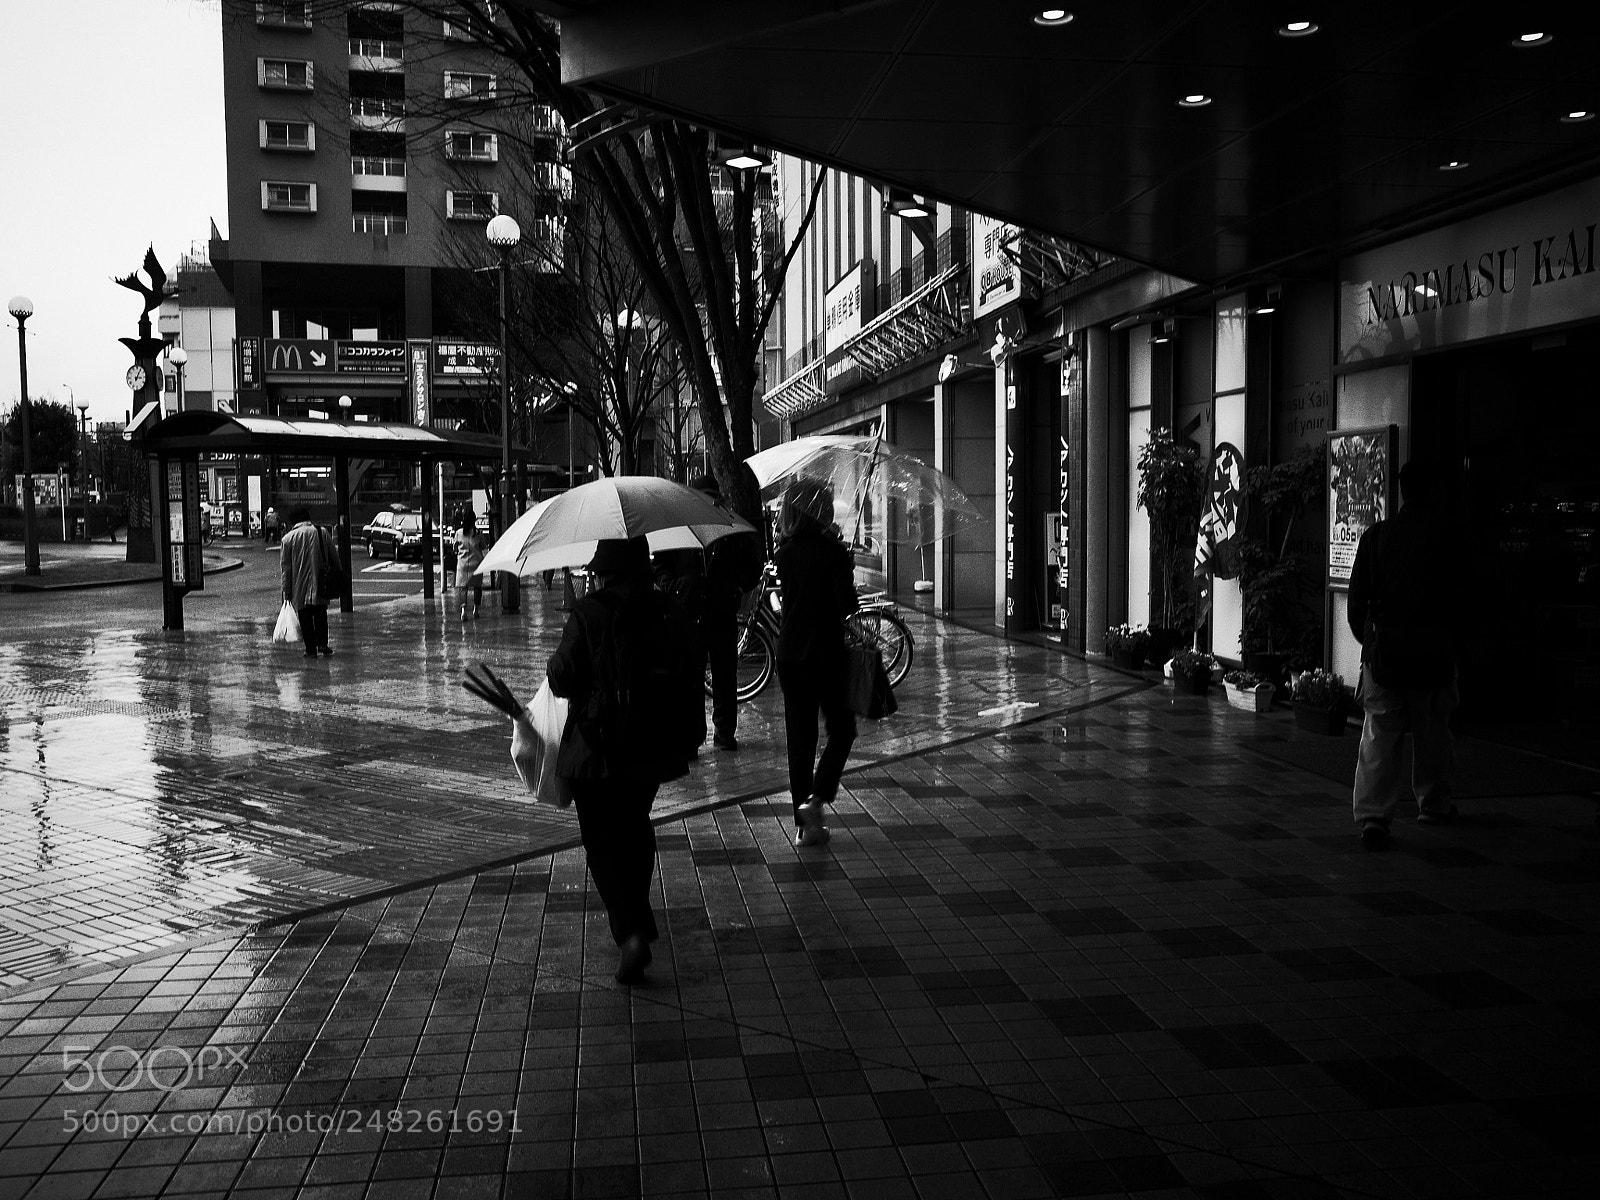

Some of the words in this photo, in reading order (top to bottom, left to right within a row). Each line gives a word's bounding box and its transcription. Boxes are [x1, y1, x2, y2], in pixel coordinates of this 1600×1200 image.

[981, 271, 991, 292] QB
[992, 263, 1014, 287] HOUSE
[1366, 245, 1519, 325] NARIMASU
[347, 346, 405, 357] ココカラファイン
